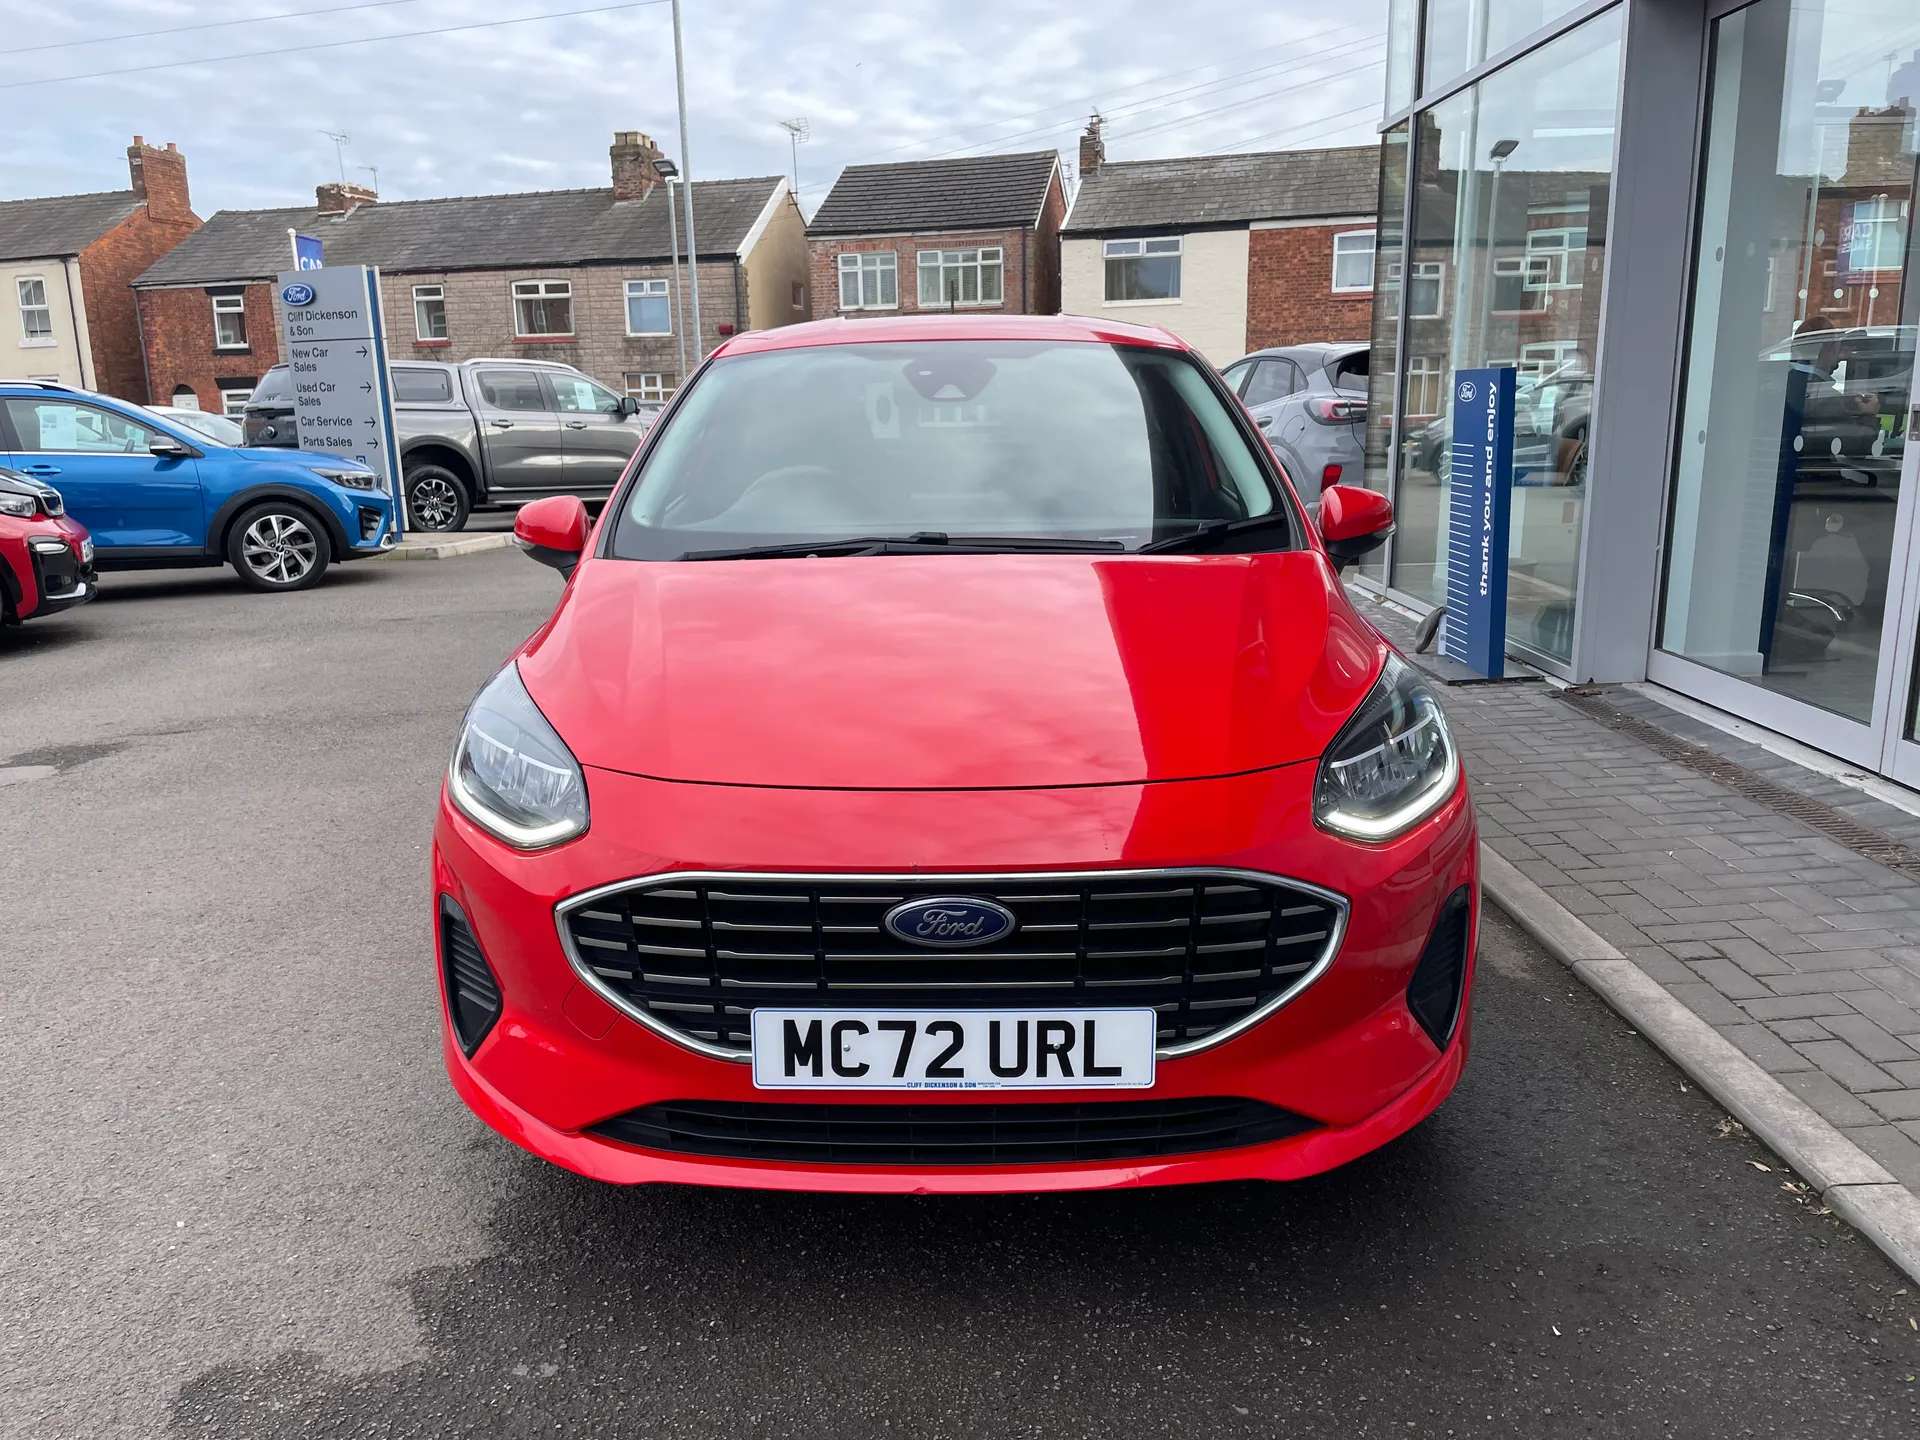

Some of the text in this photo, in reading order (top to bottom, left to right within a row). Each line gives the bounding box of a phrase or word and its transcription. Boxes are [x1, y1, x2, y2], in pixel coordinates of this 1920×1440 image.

[288, 309, 358, 322] Cliff Dickenson
[290, 325, 314, 336] & Son
[292, 347, 329, 359] New Car
[294, 362, 317, 373] Sales
[296, 382, 336, 393] Used Car
[298, 396, 321, 407] Sales
[301, 416, 353, 427] Car Service
[303, 437, 353, 447] Parts Sales
[1480, 381, 1497, 596] thank you and enjoy
[916, 909, 985, 936] Ford
[783, 1019, 1122, 1078] MC72 URL
